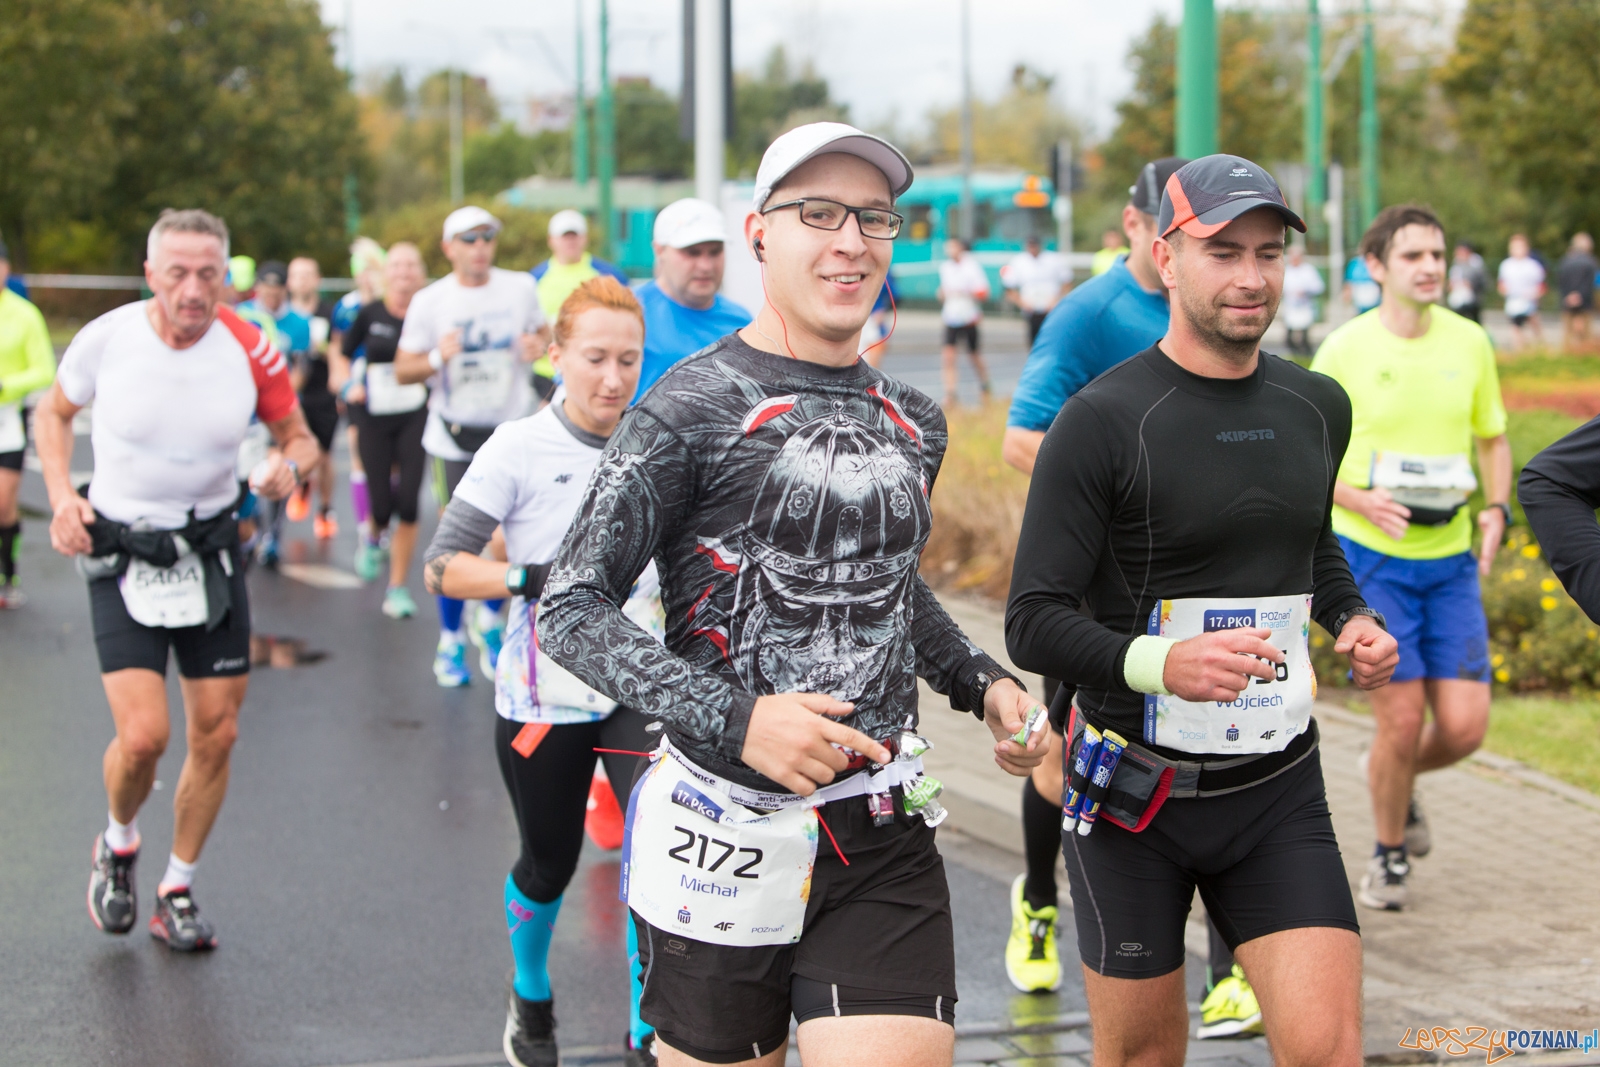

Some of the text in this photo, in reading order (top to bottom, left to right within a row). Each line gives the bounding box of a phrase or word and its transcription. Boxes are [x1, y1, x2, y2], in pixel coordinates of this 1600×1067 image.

[1228, 616, 1252, 628] PKO
[1259, 729, 1277, 740] 4F
[668, 825, 763, 879] 2172
[680, 874, 740, 898] Michał
[713, 921, 736, 932] 4F
